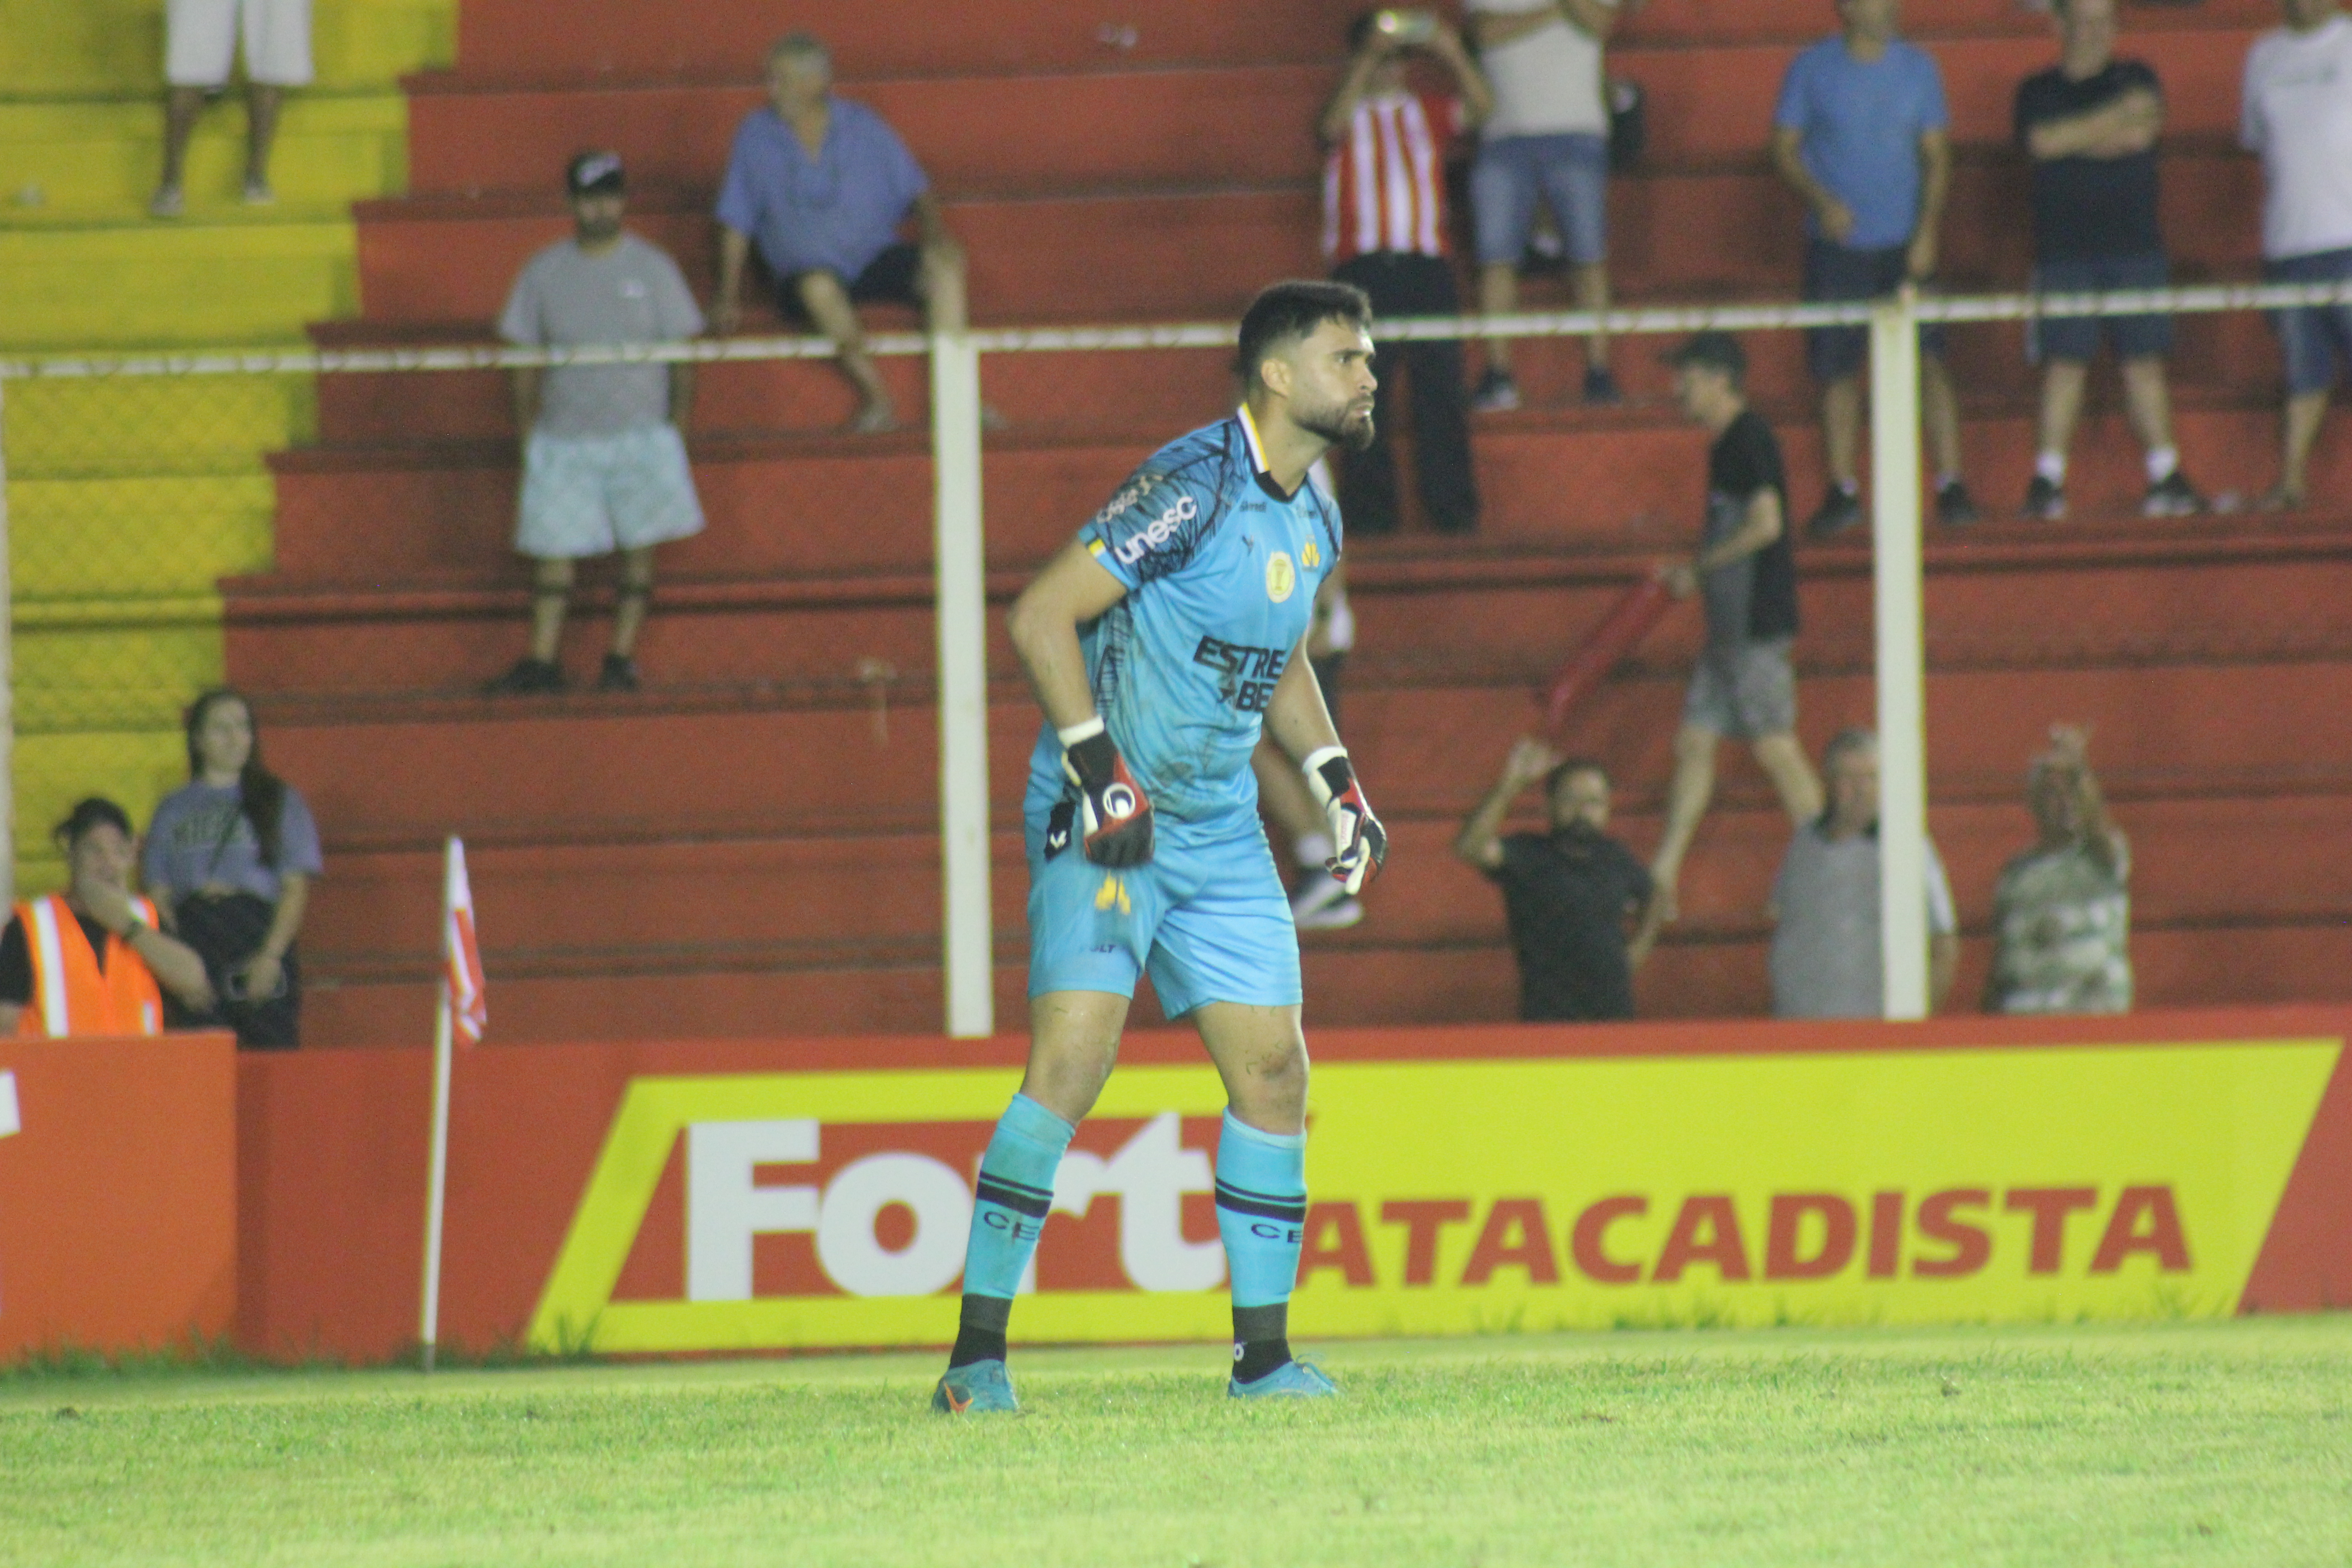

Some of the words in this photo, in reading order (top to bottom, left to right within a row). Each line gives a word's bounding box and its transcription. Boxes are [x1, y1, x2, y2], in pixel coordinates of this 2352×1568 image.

[1115, 496, 1197, 564] unesc
[1193, 636, 1286, 678] ESTRE
[1236, 681, 1275, 712] BE
[1295, 1185, 2193, 1289] ATACADISTA
